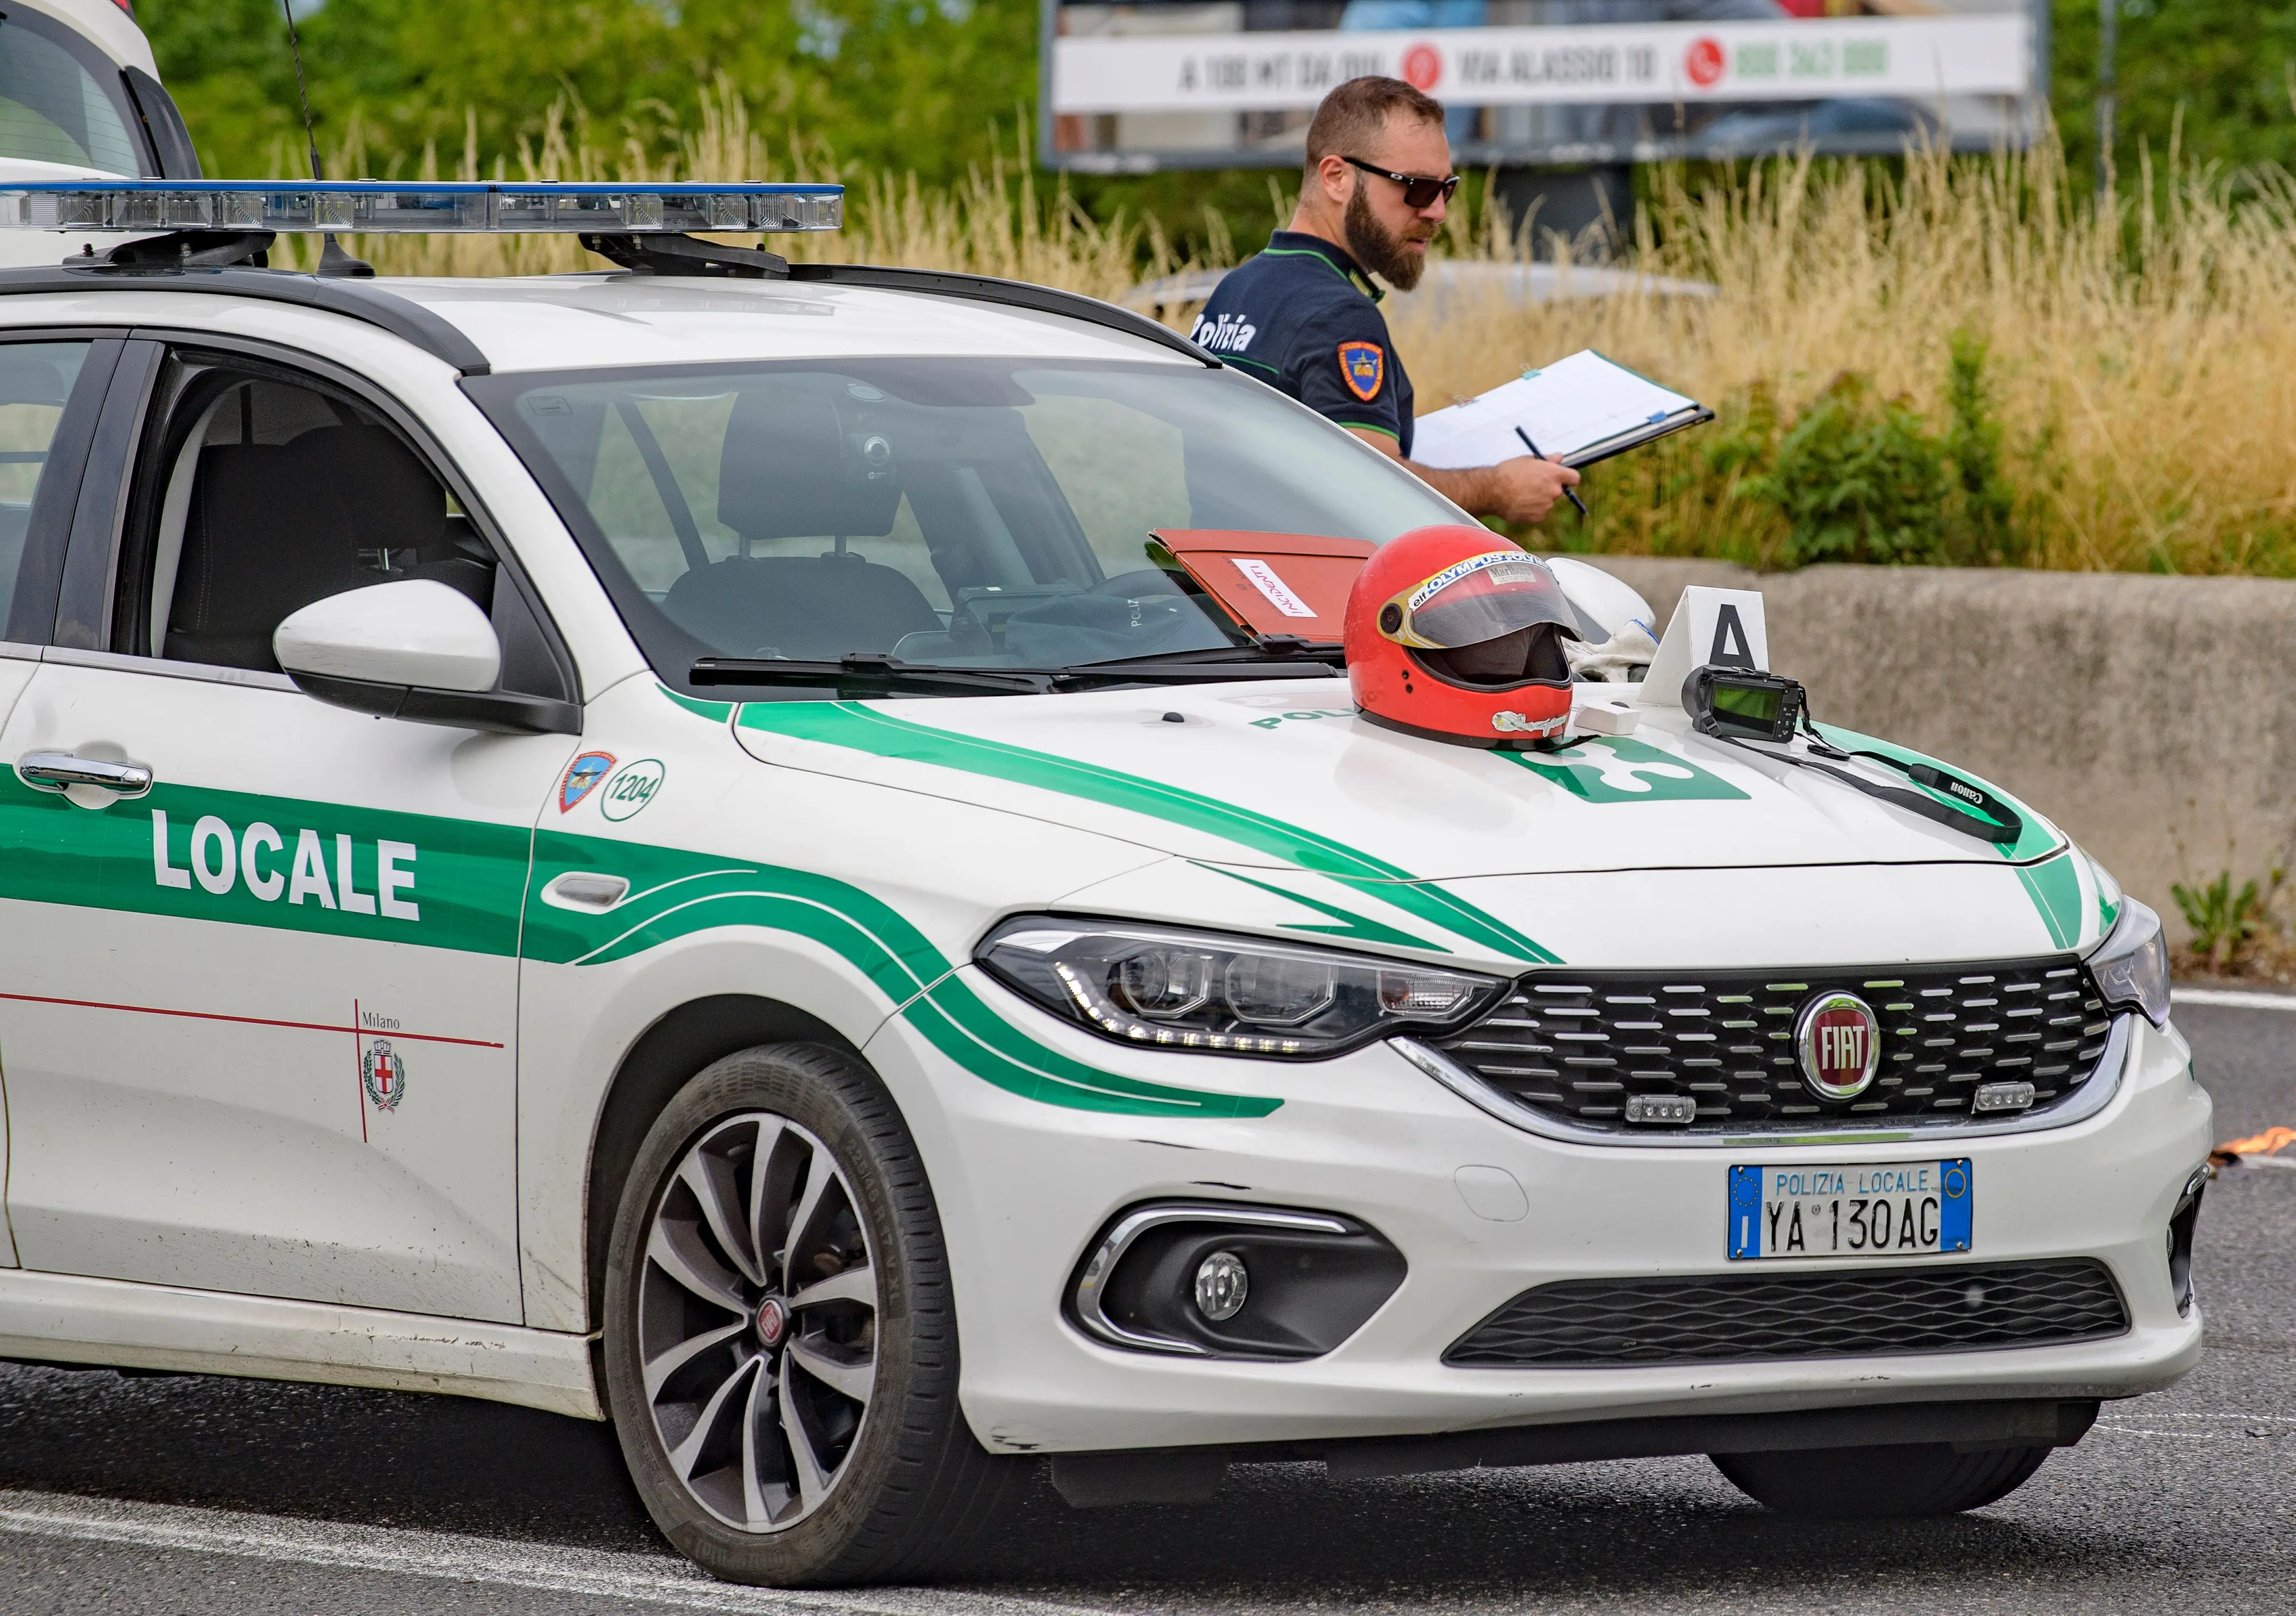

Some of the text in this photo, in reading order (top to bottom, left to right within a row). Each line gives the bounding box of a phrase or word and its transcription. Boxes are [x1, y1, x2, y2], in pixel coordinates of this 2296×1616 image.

[1189, 313, 1256, 351] Polizia
[1249, 565, 1304, 615] INCIDENTI
[1413, 591, 1427, 607] elf
[1429, 553, 1503, 591] OLYMPUS
[1709, 604, 1756, 670] A
[610, 774, 660, 803] 1204
[1950, 782, 1983, 805] Canon
[151, 809, 421, 922] LOCALE
[362, 1012, 400, 1030] Milano
[1821, 1025, 1865, 1070] FIAT
[1776, 1170, 1929, 1195] POLIZIA LOCALE
